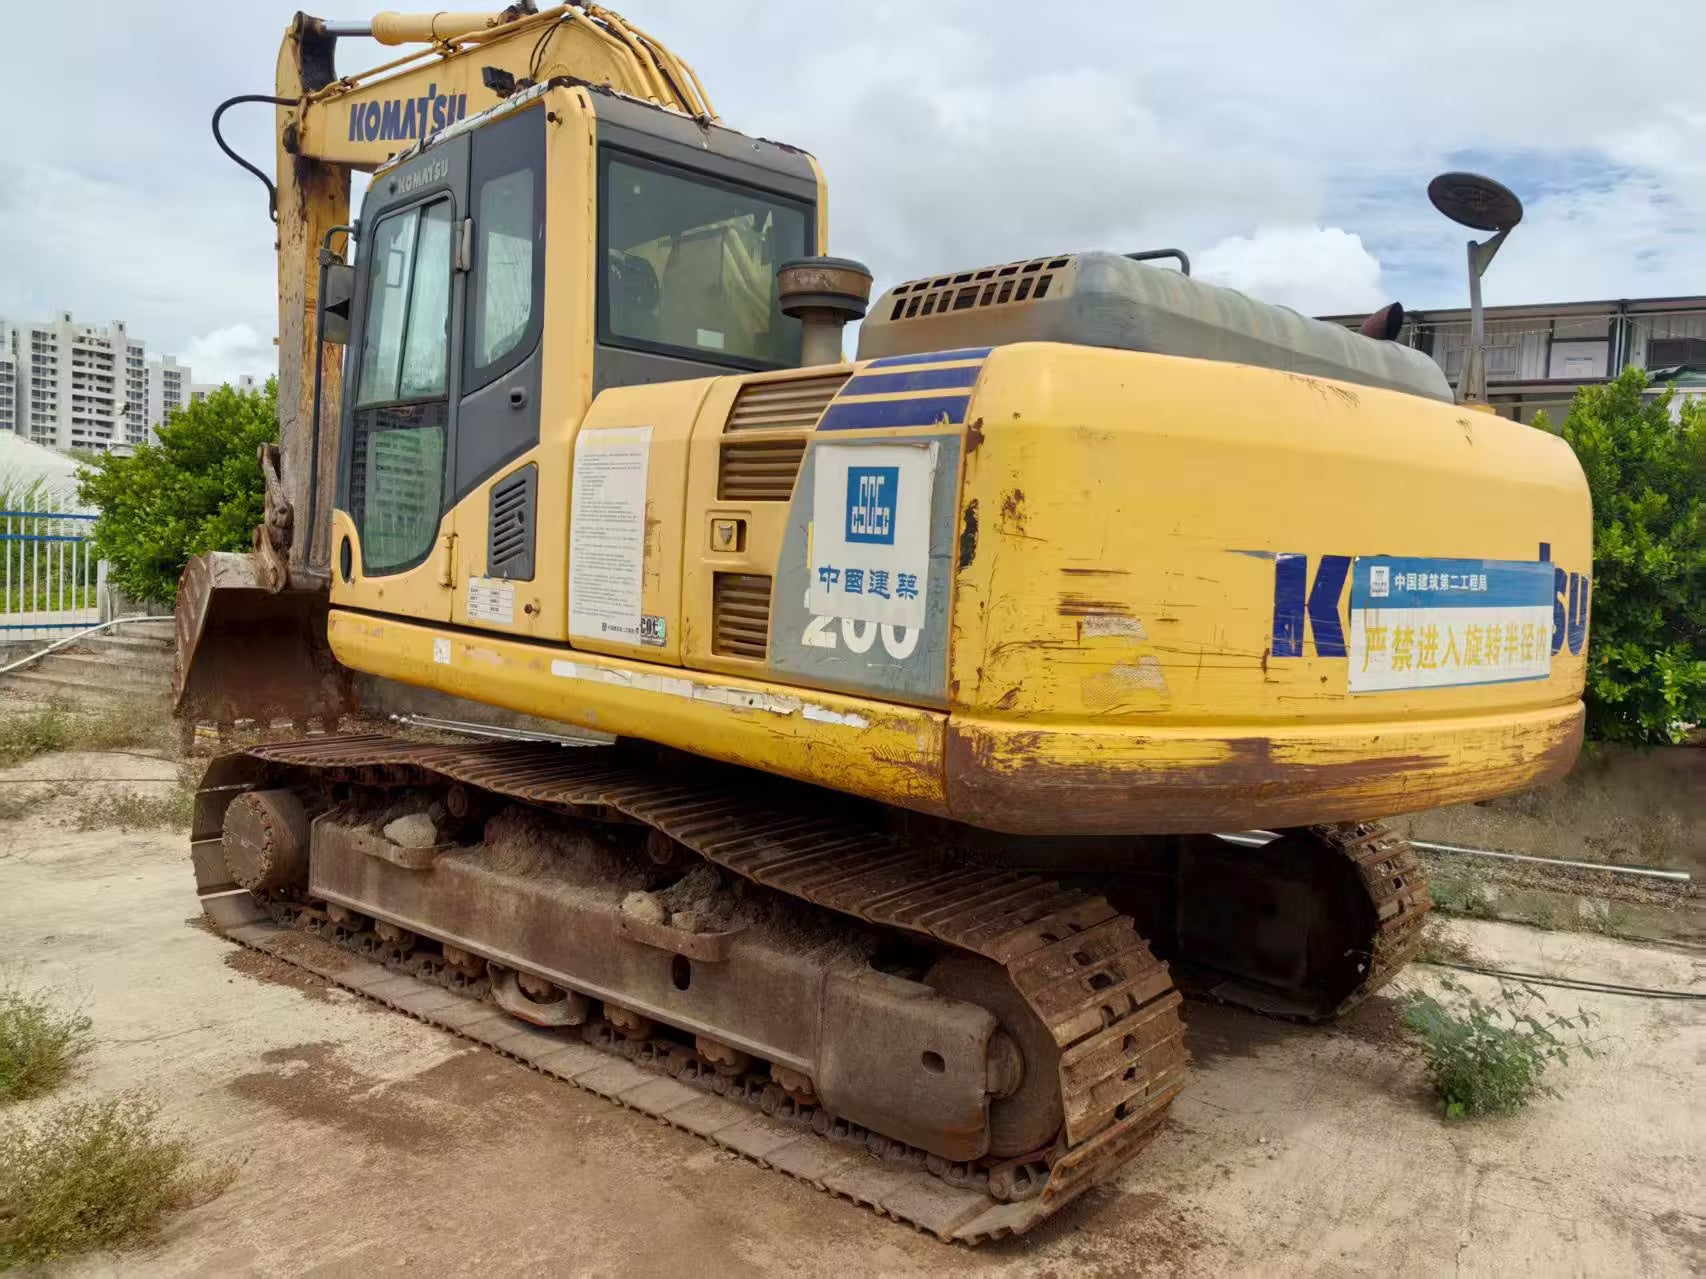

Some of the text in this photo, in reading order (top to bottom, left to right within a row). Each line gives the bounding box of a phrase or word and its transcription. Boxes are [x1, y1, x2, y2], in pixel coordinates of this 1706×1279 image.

[348, 83, 468, 142] KOMATSU
[399, 159, 449, 193] KOMATSU
[1395, 571, 1488, 592] 中国建筑第二工程局
[801, 604, 921, 660] 200
[1361, 622, 1549, 673] 严禁进入旋转半径内
